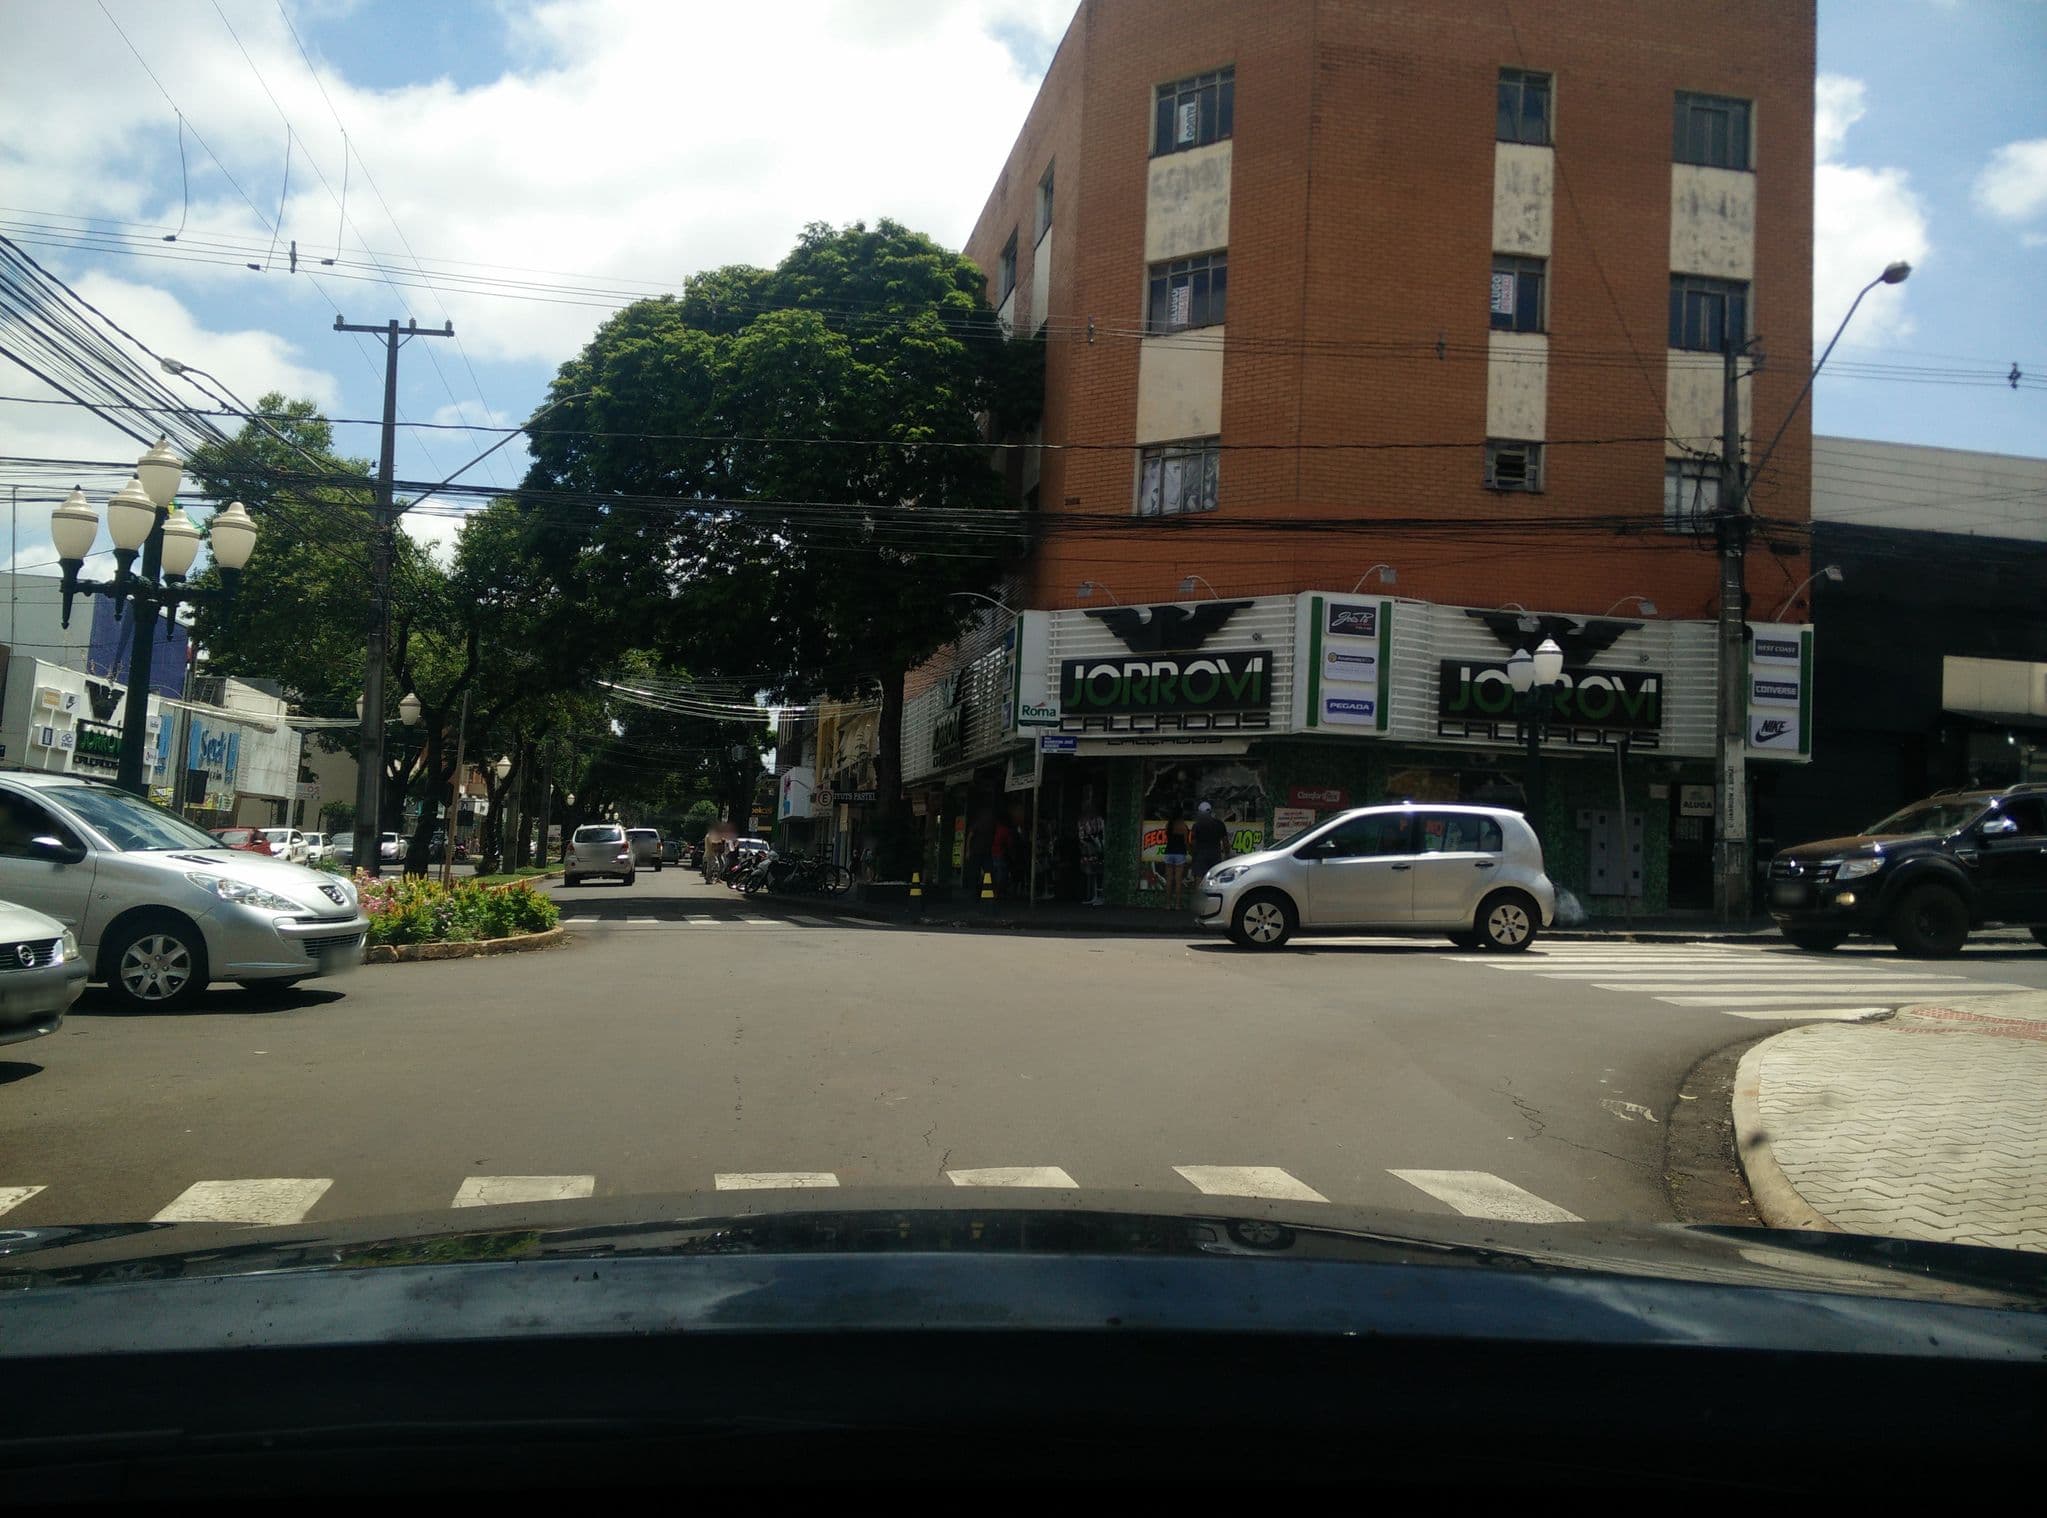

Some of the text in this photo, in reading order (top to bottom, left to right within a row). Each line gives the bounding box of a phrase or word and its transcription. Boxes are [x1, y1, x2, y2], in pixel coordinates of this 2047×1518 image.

[1064, 656, 1264, 708] JORROVI
[1447, 666, 1657, 722] JOROVI
[1755, 686, 1797, 696] CONVERSE
[1022, 704, 1057, 718] Roma
[1329, 702, 1370, 711] PEGADA
[1761, 720, 1785, 733] NIKE
